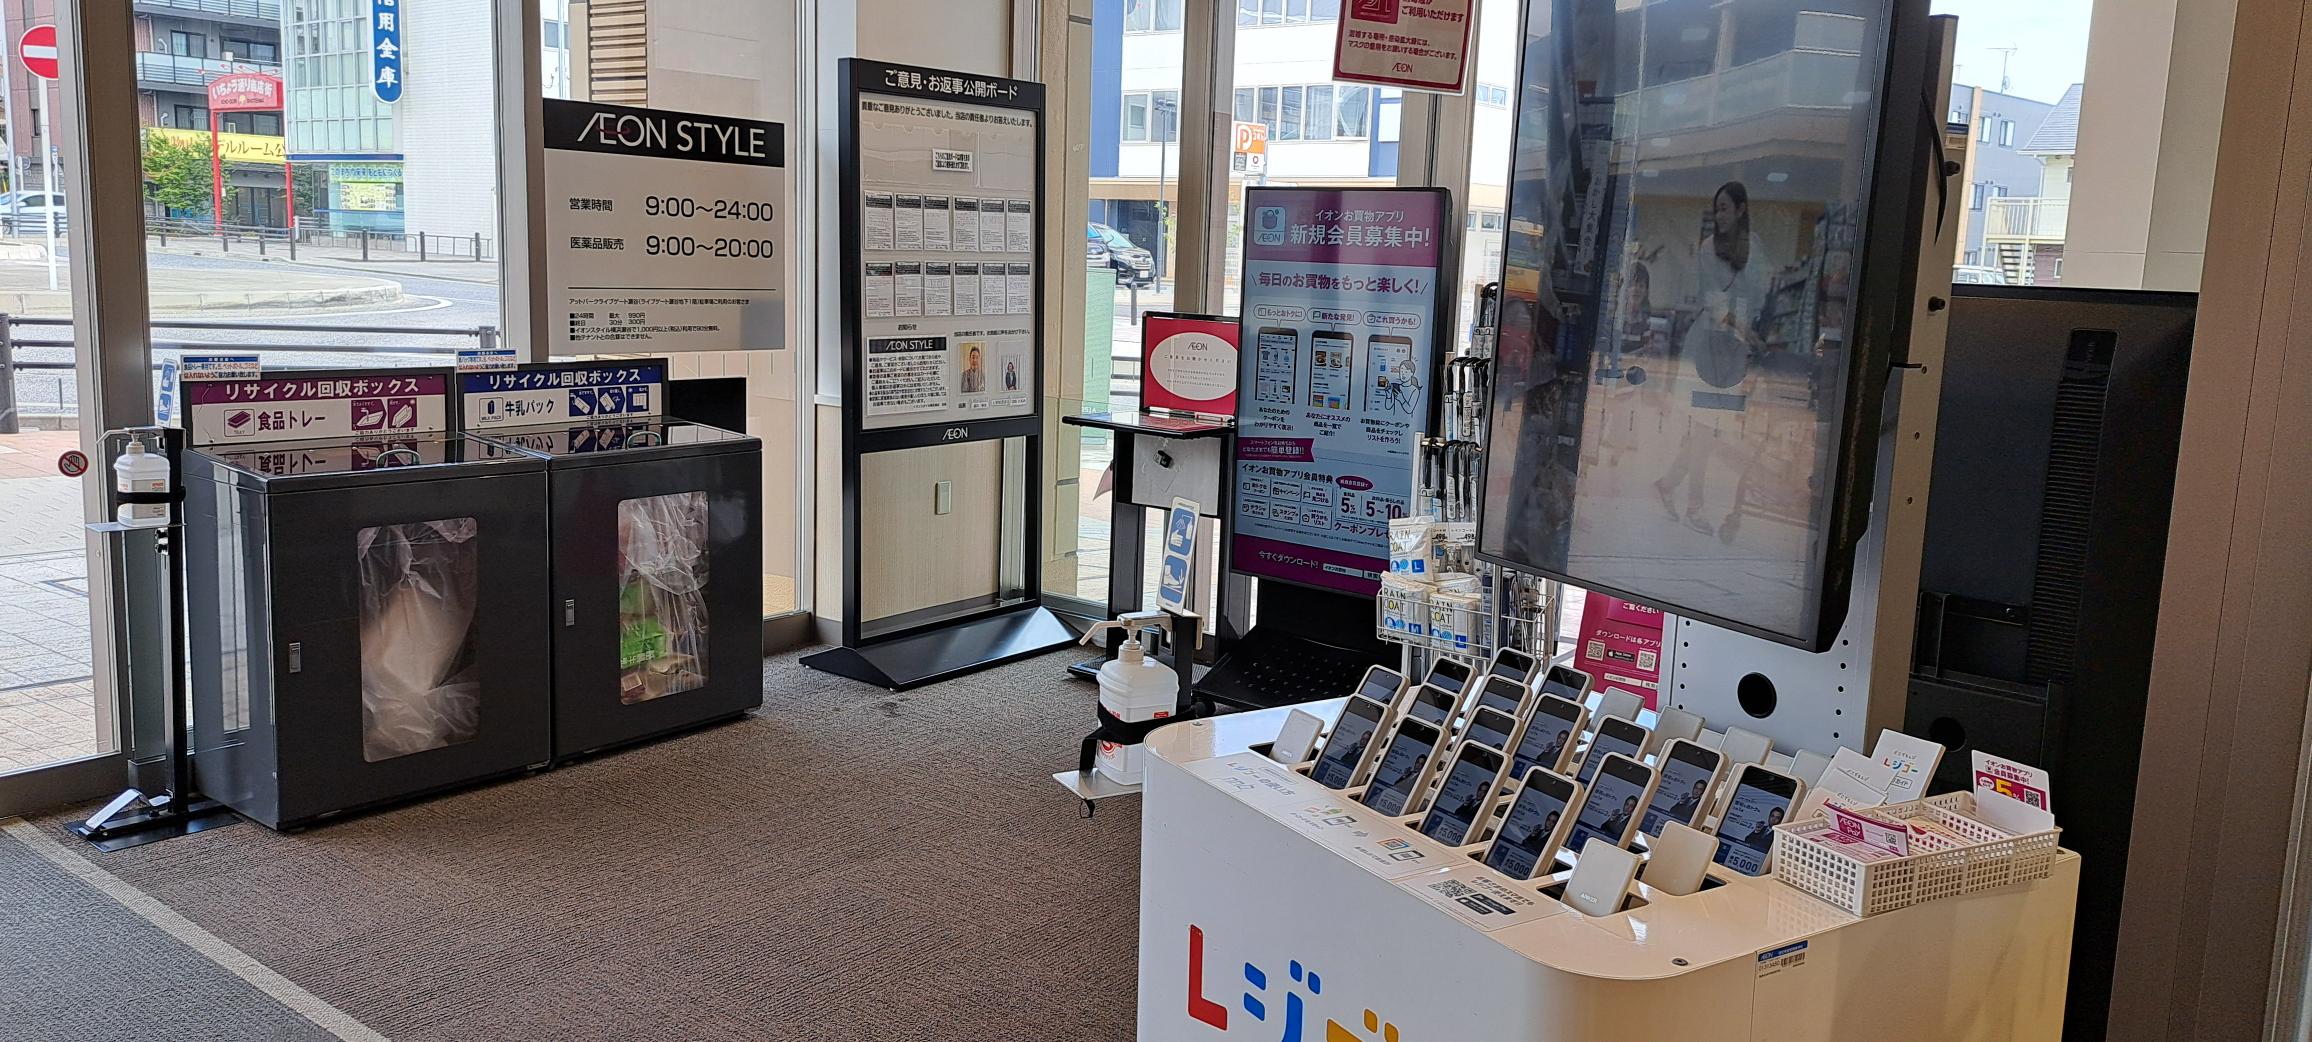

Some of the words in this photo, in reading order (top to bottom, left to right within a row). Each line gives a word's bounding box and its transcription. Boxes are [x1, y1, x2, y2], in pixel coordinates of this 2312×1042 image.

[1401, 6, 1464, 22] ご利用いただけます
[885, 69, 1018, 100] ご意見・お返事公開ボード
[676, 120, 766, 158] STYLE
[569, 197, 613, 212] 営業時間
[1315, 209, 1404, 223] イオンお買物アプリ
[570, 236, 625, 251] 医薬品販売
[1290, 224, 1430, 248] 新規会員募集中!
[1259, 272, 1420, 294] 毎日のお買物をもっと楽しく!
[909, 339, 934, 350] STYLE
[489, 368, 641, 390] リサイクル回収ボックス
[225, 378, 420, 400] リサイクル回収ボックス
[505, 399, 554, 417] 牛乳パック
[258, 410, 326, 431] 食品トレー
[1259, 550, 1319, 569] 今すぐダウンロード!
[1384, 588, 1406, 599] RAIN
[1622, 602, 1660, 614] ご覧ください
[1883, 758, 1918, 774] レジゴー
[1847, 827, 1861, 836] Pay
